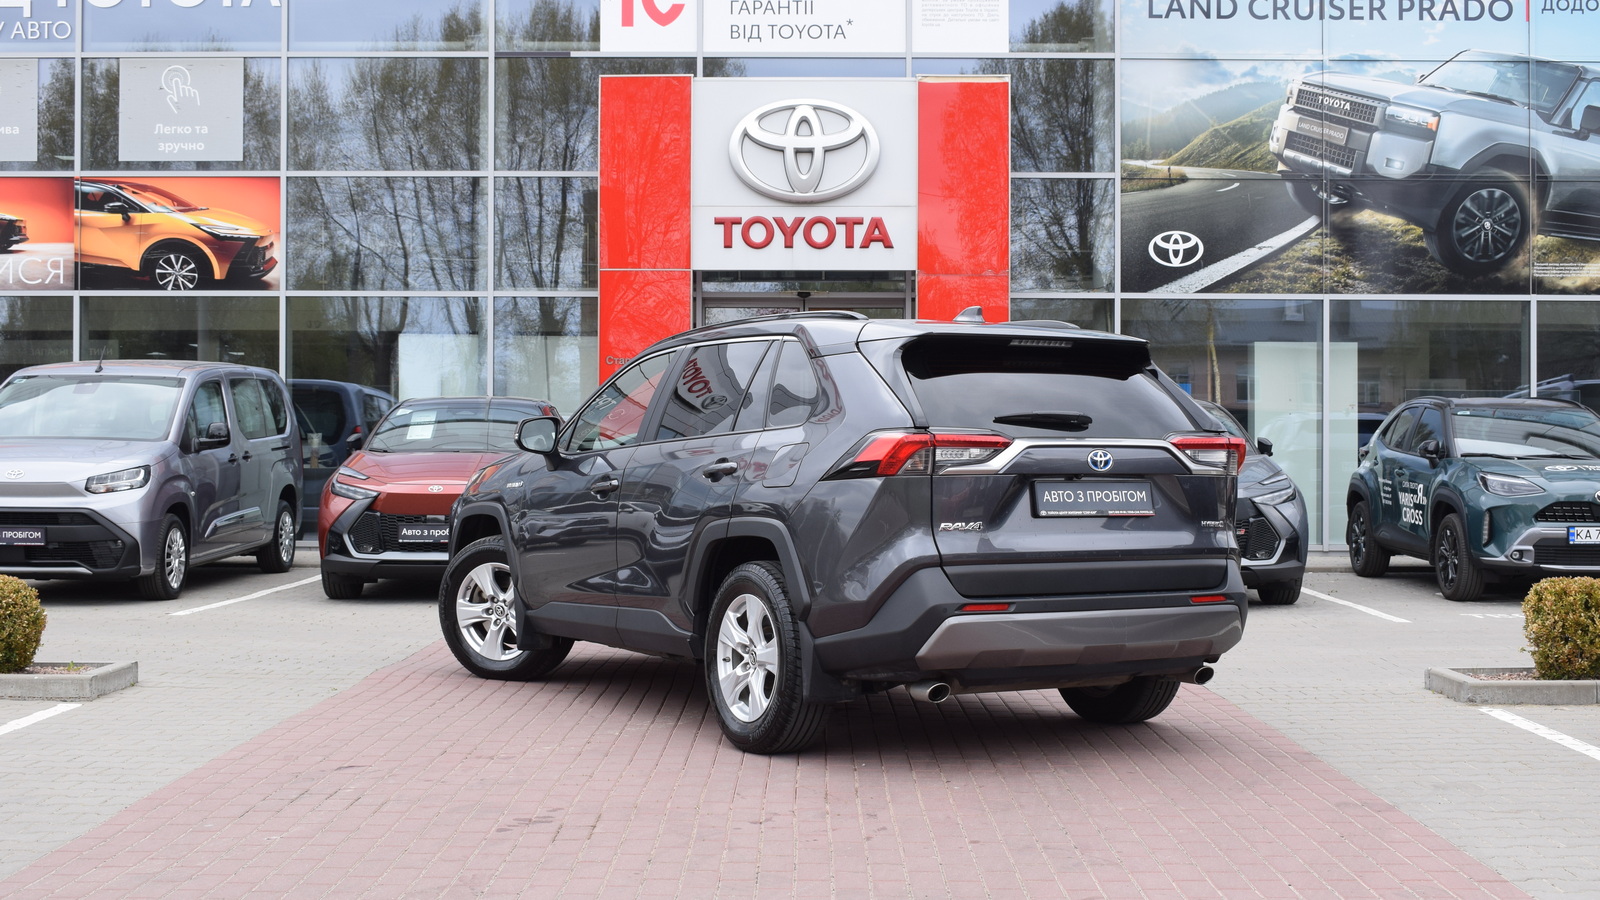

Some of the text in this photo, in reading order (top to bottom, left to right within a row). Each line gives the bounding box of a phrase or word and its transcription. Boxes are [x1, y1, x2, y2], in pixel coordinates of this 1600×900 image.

[1148, 0, 1514, 22] LAND CRUISER PRADO
[10, 20, 72, 39] АВТО
[730, 24, 762, 42] ВІД
[1318, 96, 1351, 111] TOYOTA
[154, 123, 209, 134] Легко та
[1298, 122, 1310, 131] LAND
[158, 142, 205, 153] зручно
[713, 216, 895, 249] TOYOTA
[1043, 490, 1074, 503] АВТО
[1086, 490, 1147, 503] ПРОБІГОМ
[1398, 491, 1414, 507] YARIS
[1402, 507, 1423, 525] CROSS
[401, 527, 421, 536] Авто
[939, 521, 983, 531] RAV4
[2, 531, 41, 539] ПРОБІГОМ
[1576, 529, 1592, 540] KA
